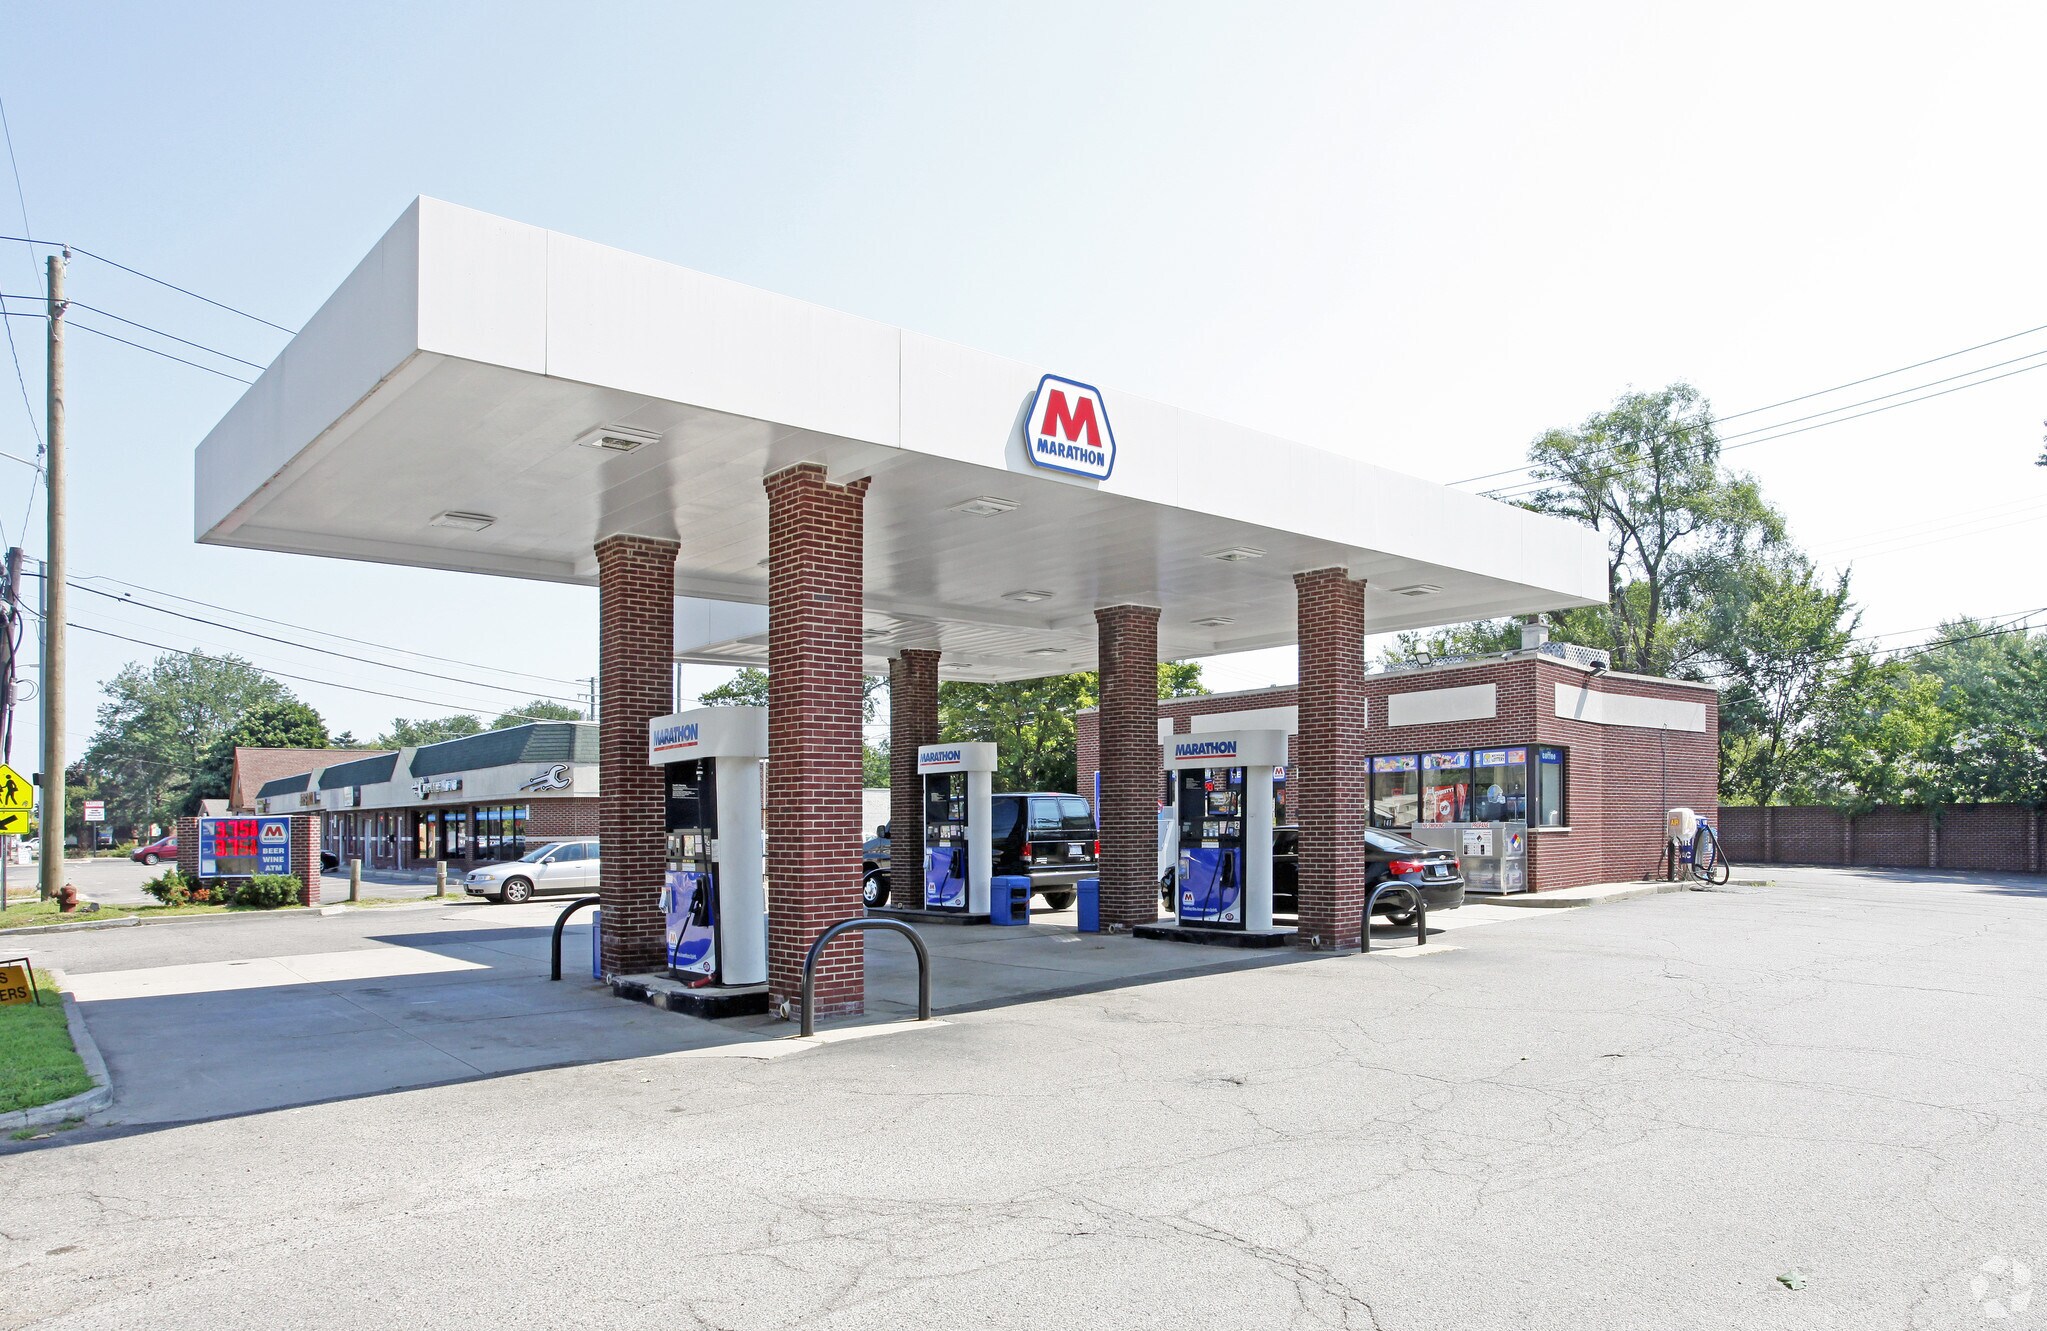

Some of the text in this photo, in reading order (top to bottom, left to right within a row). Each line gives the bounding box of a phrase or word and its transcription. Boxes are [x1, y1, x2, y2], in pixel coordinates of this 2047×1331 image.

[1041, 389, 1102, 449] M
[1037, 438, 1105, 467] MARATHON
[653, 723, 699, 746] MARATHON
[920, 750, 960, 762] MARATHON
[1175, 741, 1237, 756] MARATHON
[264, 826, 283, 836] M
